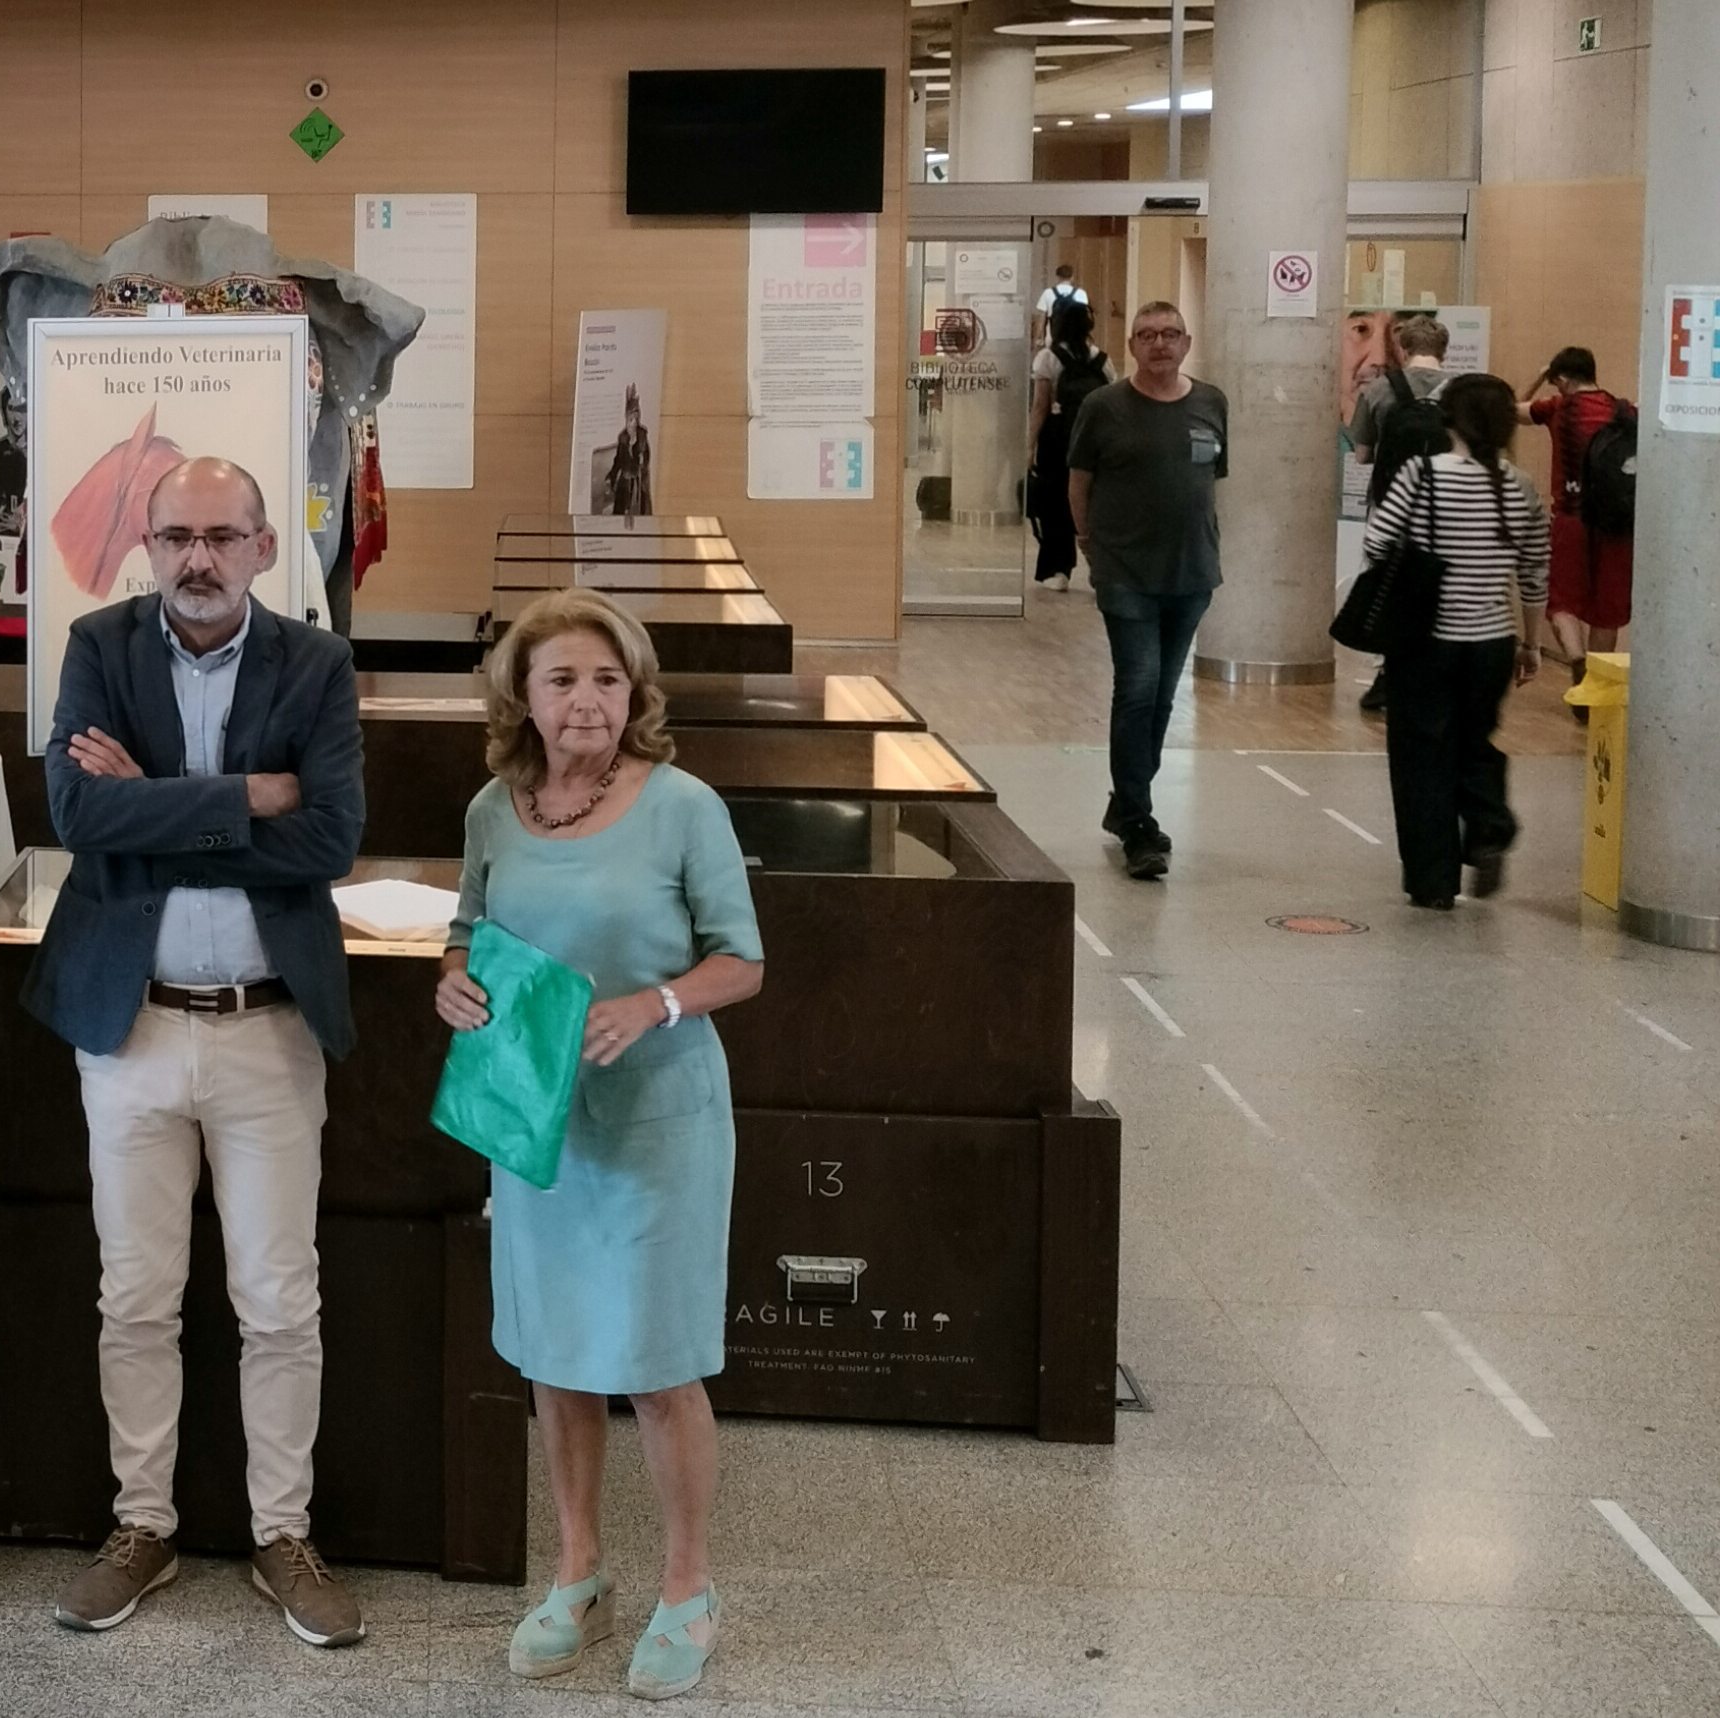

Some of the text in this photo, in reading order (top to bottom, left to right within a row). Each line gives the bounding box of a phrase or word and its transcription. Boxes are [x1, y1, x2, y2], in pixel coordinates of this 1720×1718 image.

[762, 277, 862, 298] Entrada
[51, 344, 282, 370] Aprendiendo Veterinaria
[104, 375, 231, 394] hace 150 años
[801, 1161, 844, 1198] 13
[724, 1303, 835, 1327] AGILE
[773, 1348, 801, 1357] USED
[804, 1349, 824, 1358] ARE
[828, 1350, 868, 1359] EXEMPT
[872, 1352, 885, 1360] OF
[890, 1353, 975, 1365] PHYTOSANITARY
[813, 1363, 834, 1372] FAO
